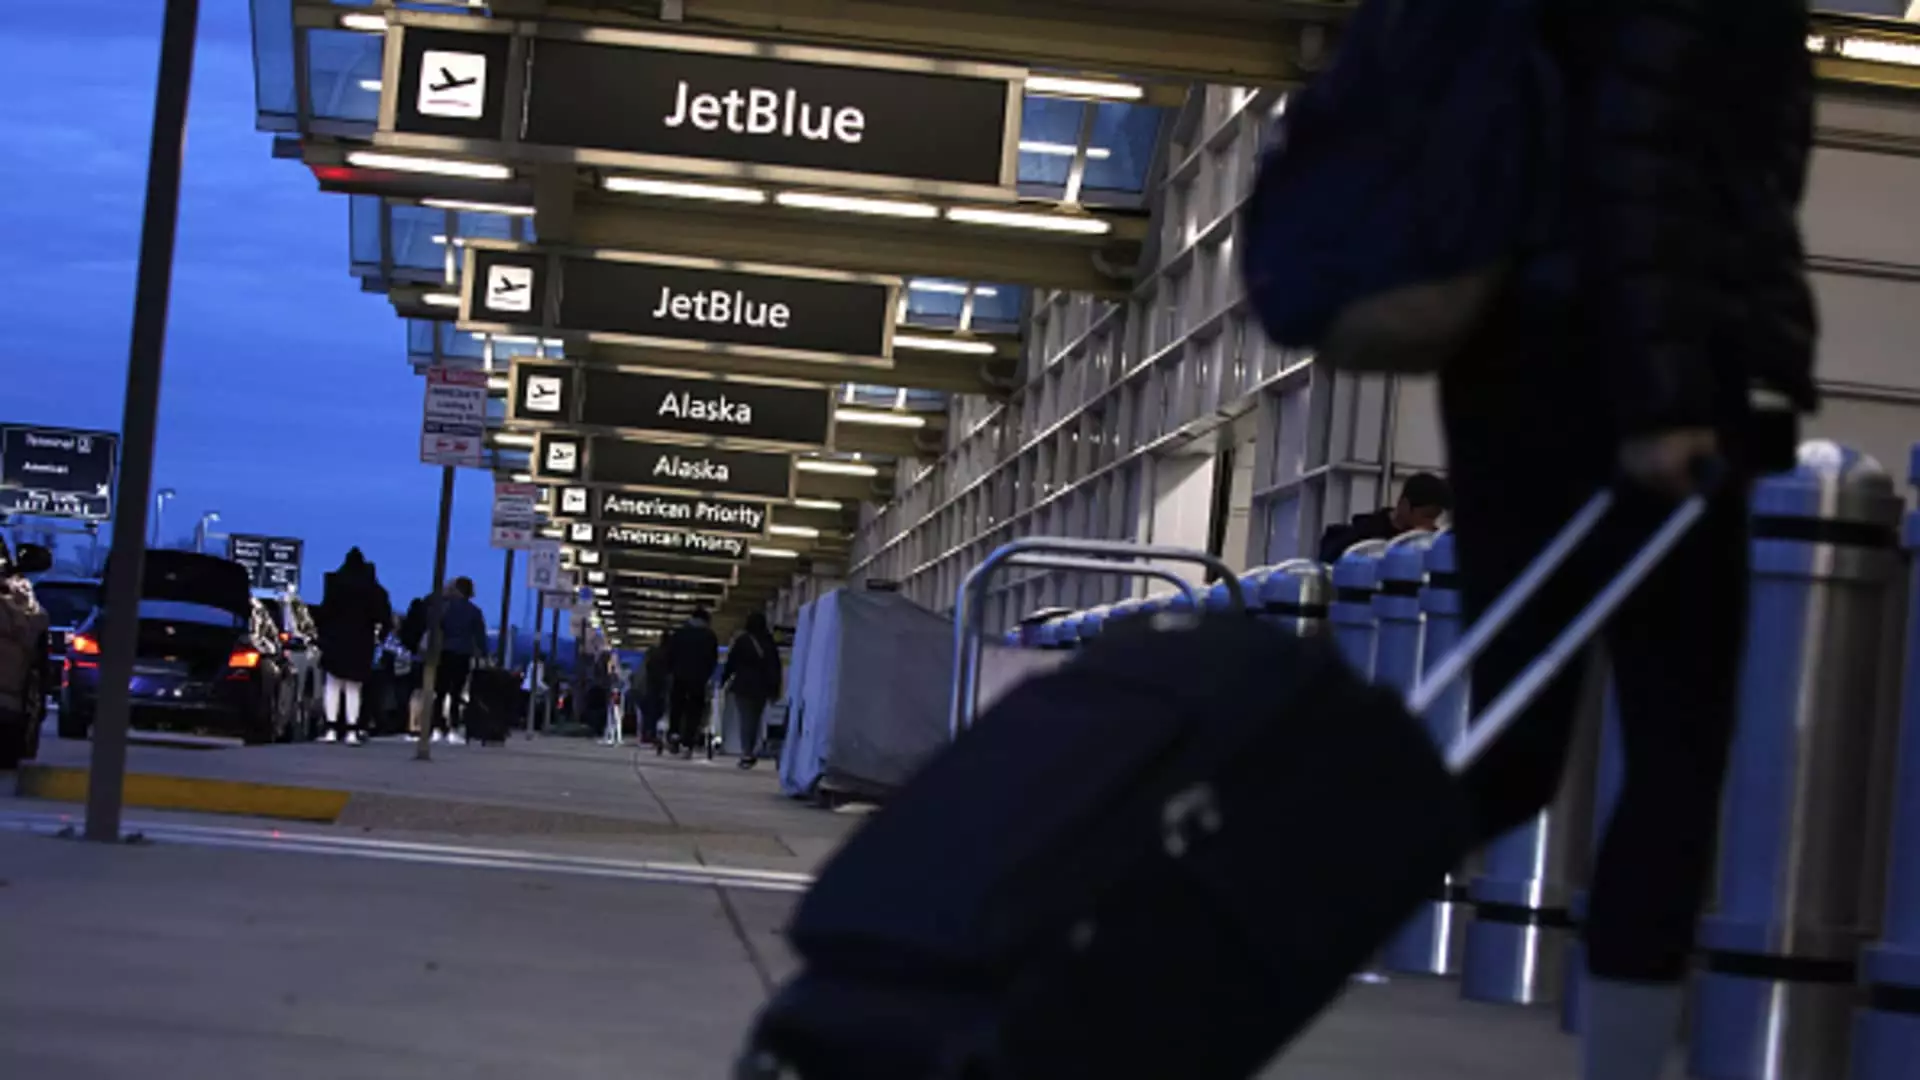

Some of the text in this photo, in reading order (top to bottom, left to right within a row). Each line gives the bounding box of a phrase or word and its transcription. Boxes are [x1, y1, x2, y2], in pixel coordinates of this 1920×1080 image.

[664, 80, 866, 144] JetBlue
[653, 286, 791, 329] JetBlue
[658, 391, 752, 425] Alaska
[653, 454, 729, 483] Alaska
[604, 493, 764, 529] American Priority
[606, 525, 744, 556] American Priority
